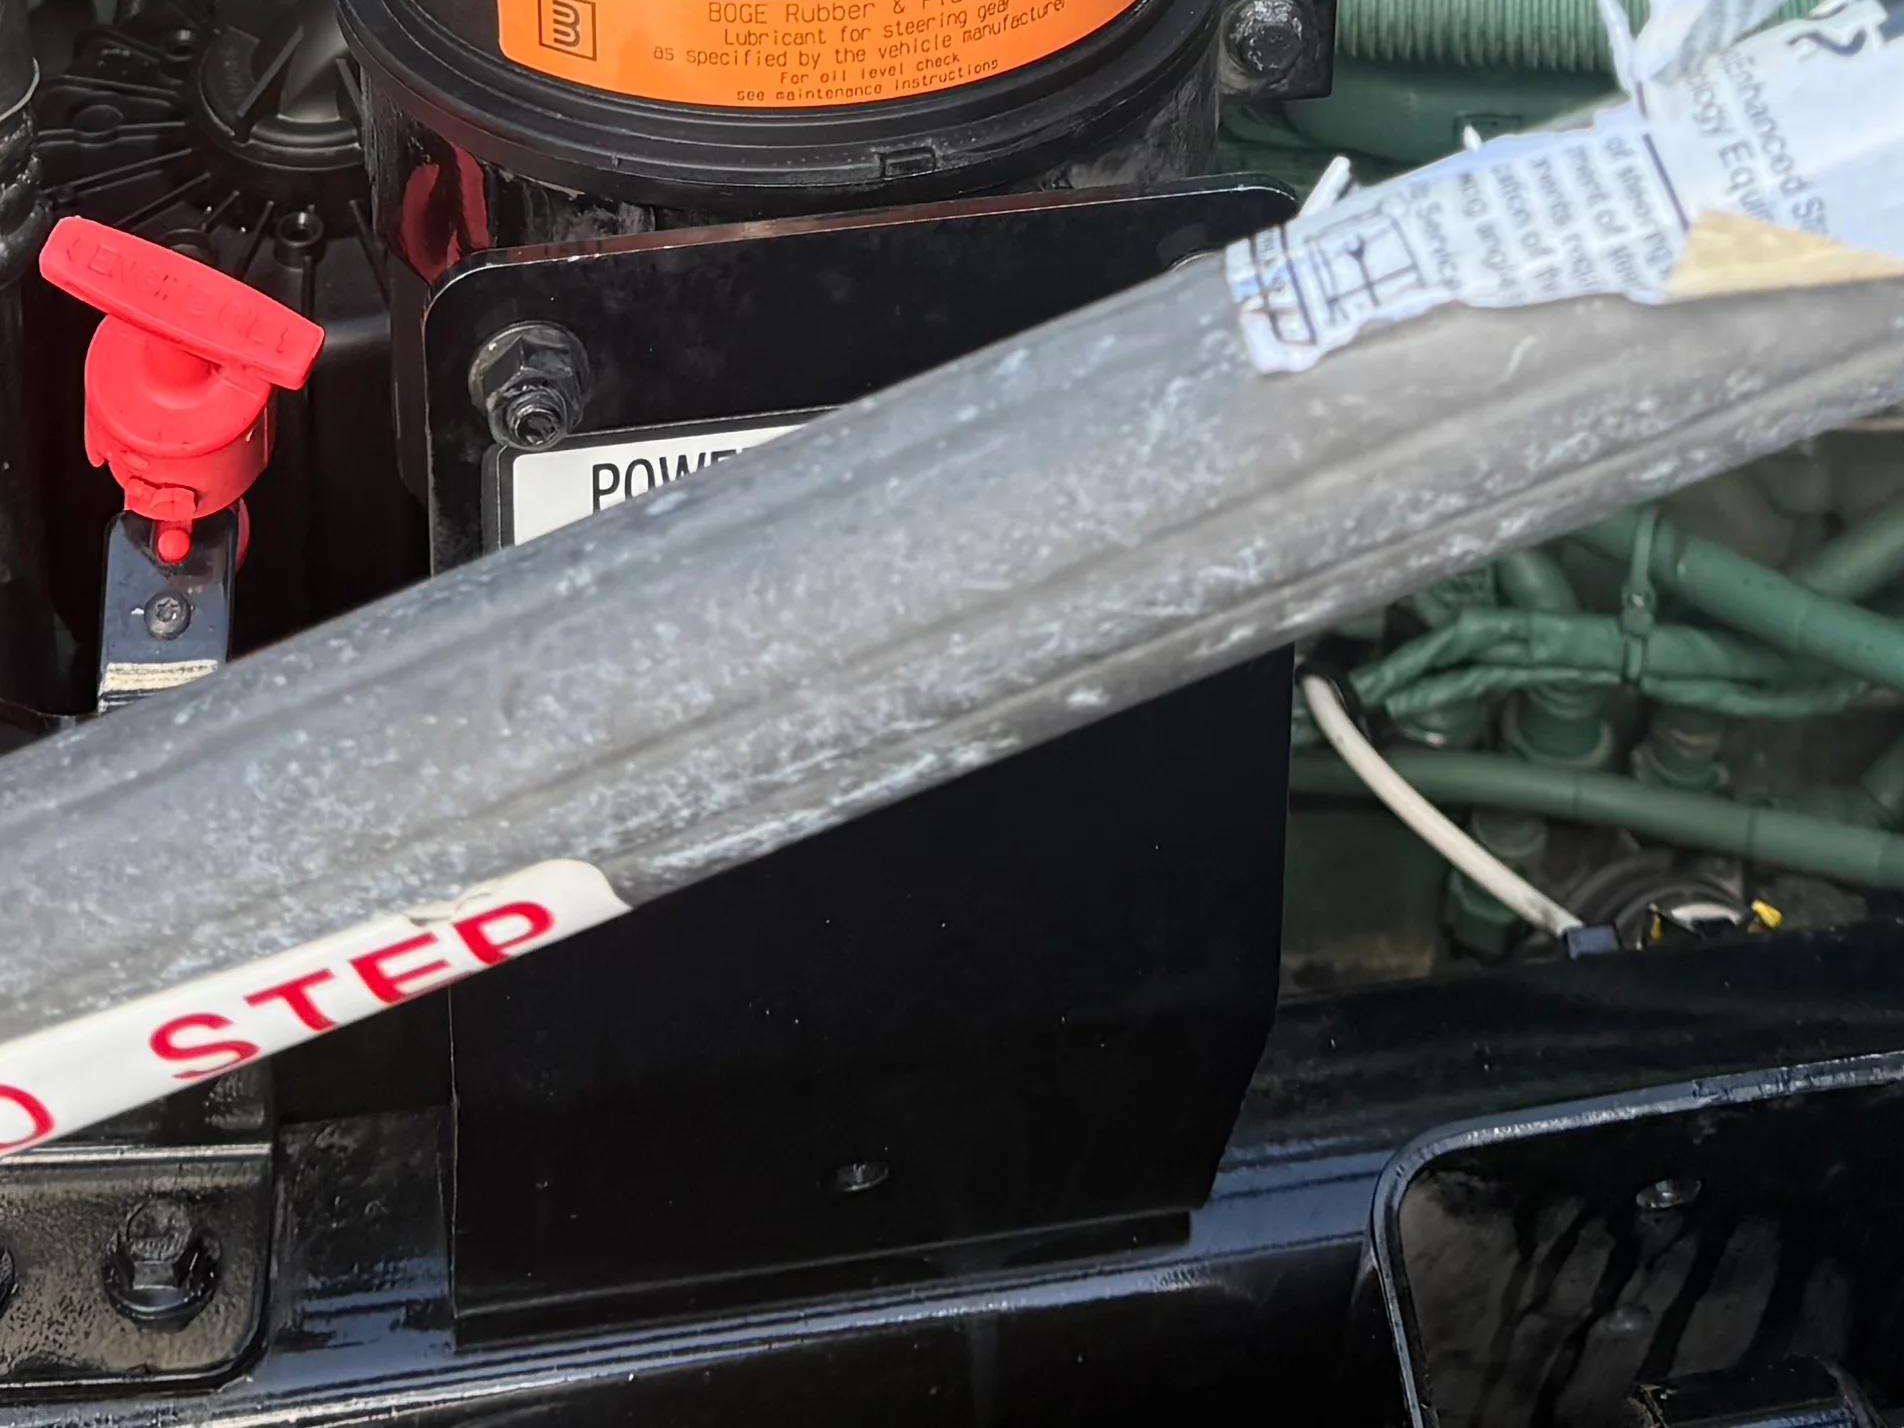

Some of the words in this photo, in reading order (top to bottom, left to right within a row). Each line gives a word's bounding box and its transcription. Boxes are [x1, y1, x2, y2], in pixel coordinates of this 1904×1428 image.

[709, 2, 768, 24] BOGE
[786, 0, 875, 23] Rubber
[724, 28, 826, 47] Lubricant
[841, 26, 871, 43] for
[884, 10, 967, 39] steering
[653, 47, 674, 61] as
[686, 47, 787, 67] specified
[798, 51, 821, 69] by
[835, 47, 866, 63] the
[878, 33, 951, 60] vehicle
[780, 71, 808, 85] For
[820, 69, 846, 84] oil
[861, 63, 904, 80] level
[916, 52, 960, 72] check
[736, 90, 765, 102] see
[776, 82, 882, 101] maintenance
[895, 58, 999, 92] instructions
[149, 899, 556, 1081] STEP
